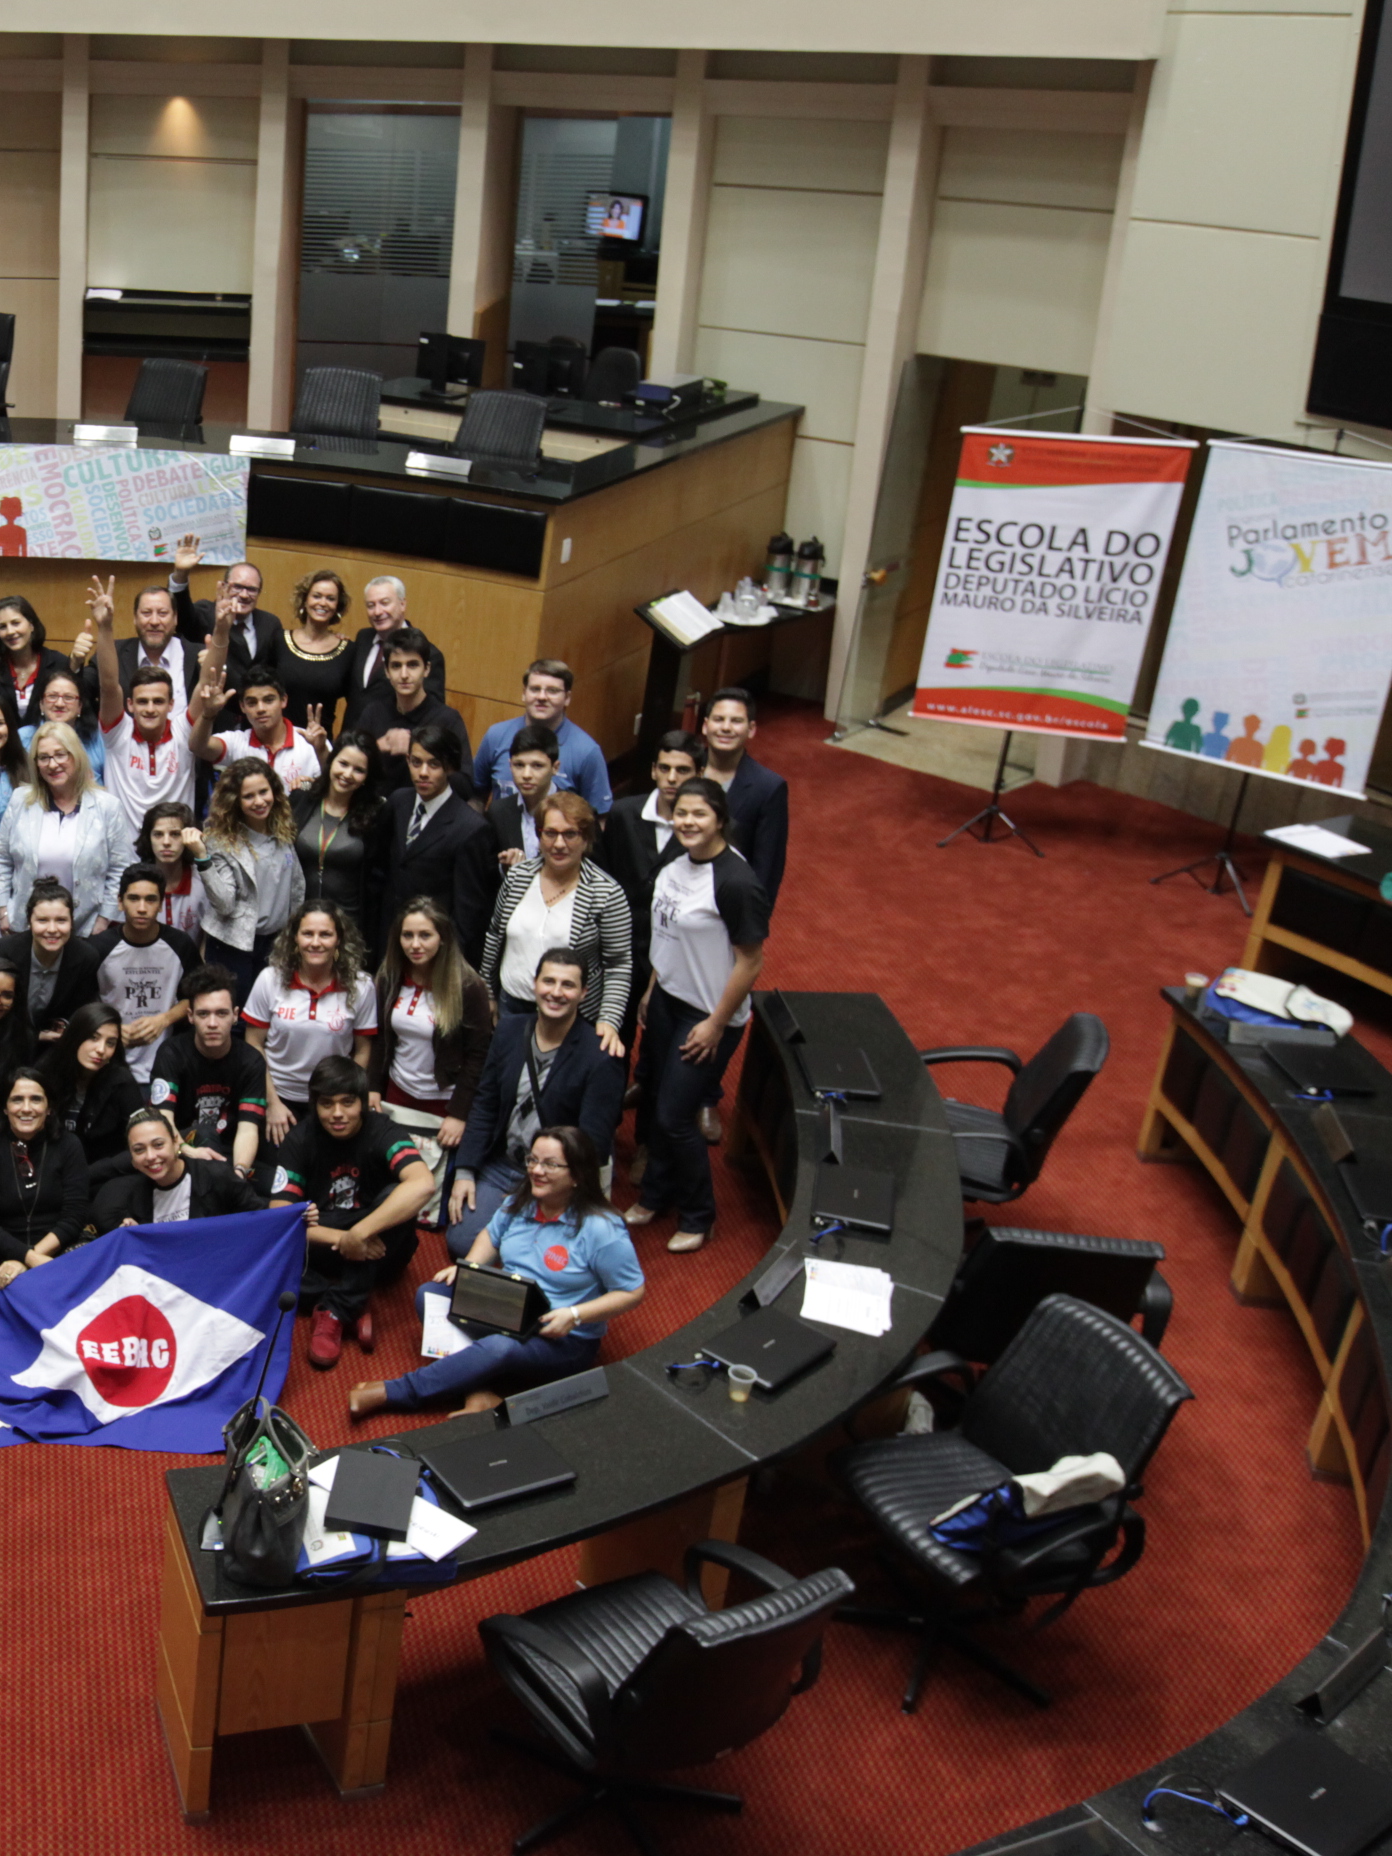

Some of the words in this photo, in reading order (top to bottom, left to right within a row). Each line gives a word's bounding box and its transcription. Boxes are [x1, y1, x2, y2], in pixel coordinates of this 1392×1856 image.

[132, 461, 203, 493] DEBATE
[138, 482, 197, 508] CULTURA
[115, 478, 143, 543] POLÍTICA
[952, 517, 1091, 554] ESCOLA
[1103, 530, 1162, 559] DO
[1227, 511, 1389, 549] Parlamento
[947, 547, 1154, 586] LEGISLATIVO
[943, 572, 1077, 602] DEPUTADO
[1083, 583, 1149, 608] LÍCIO
[940, 592, 1015, 613] MAURO
[1020, 597, 1051, 617] DA
[1056, 601, 1144, 625] SILVEIRA
[277, 1006, 296, 1020] PJE
